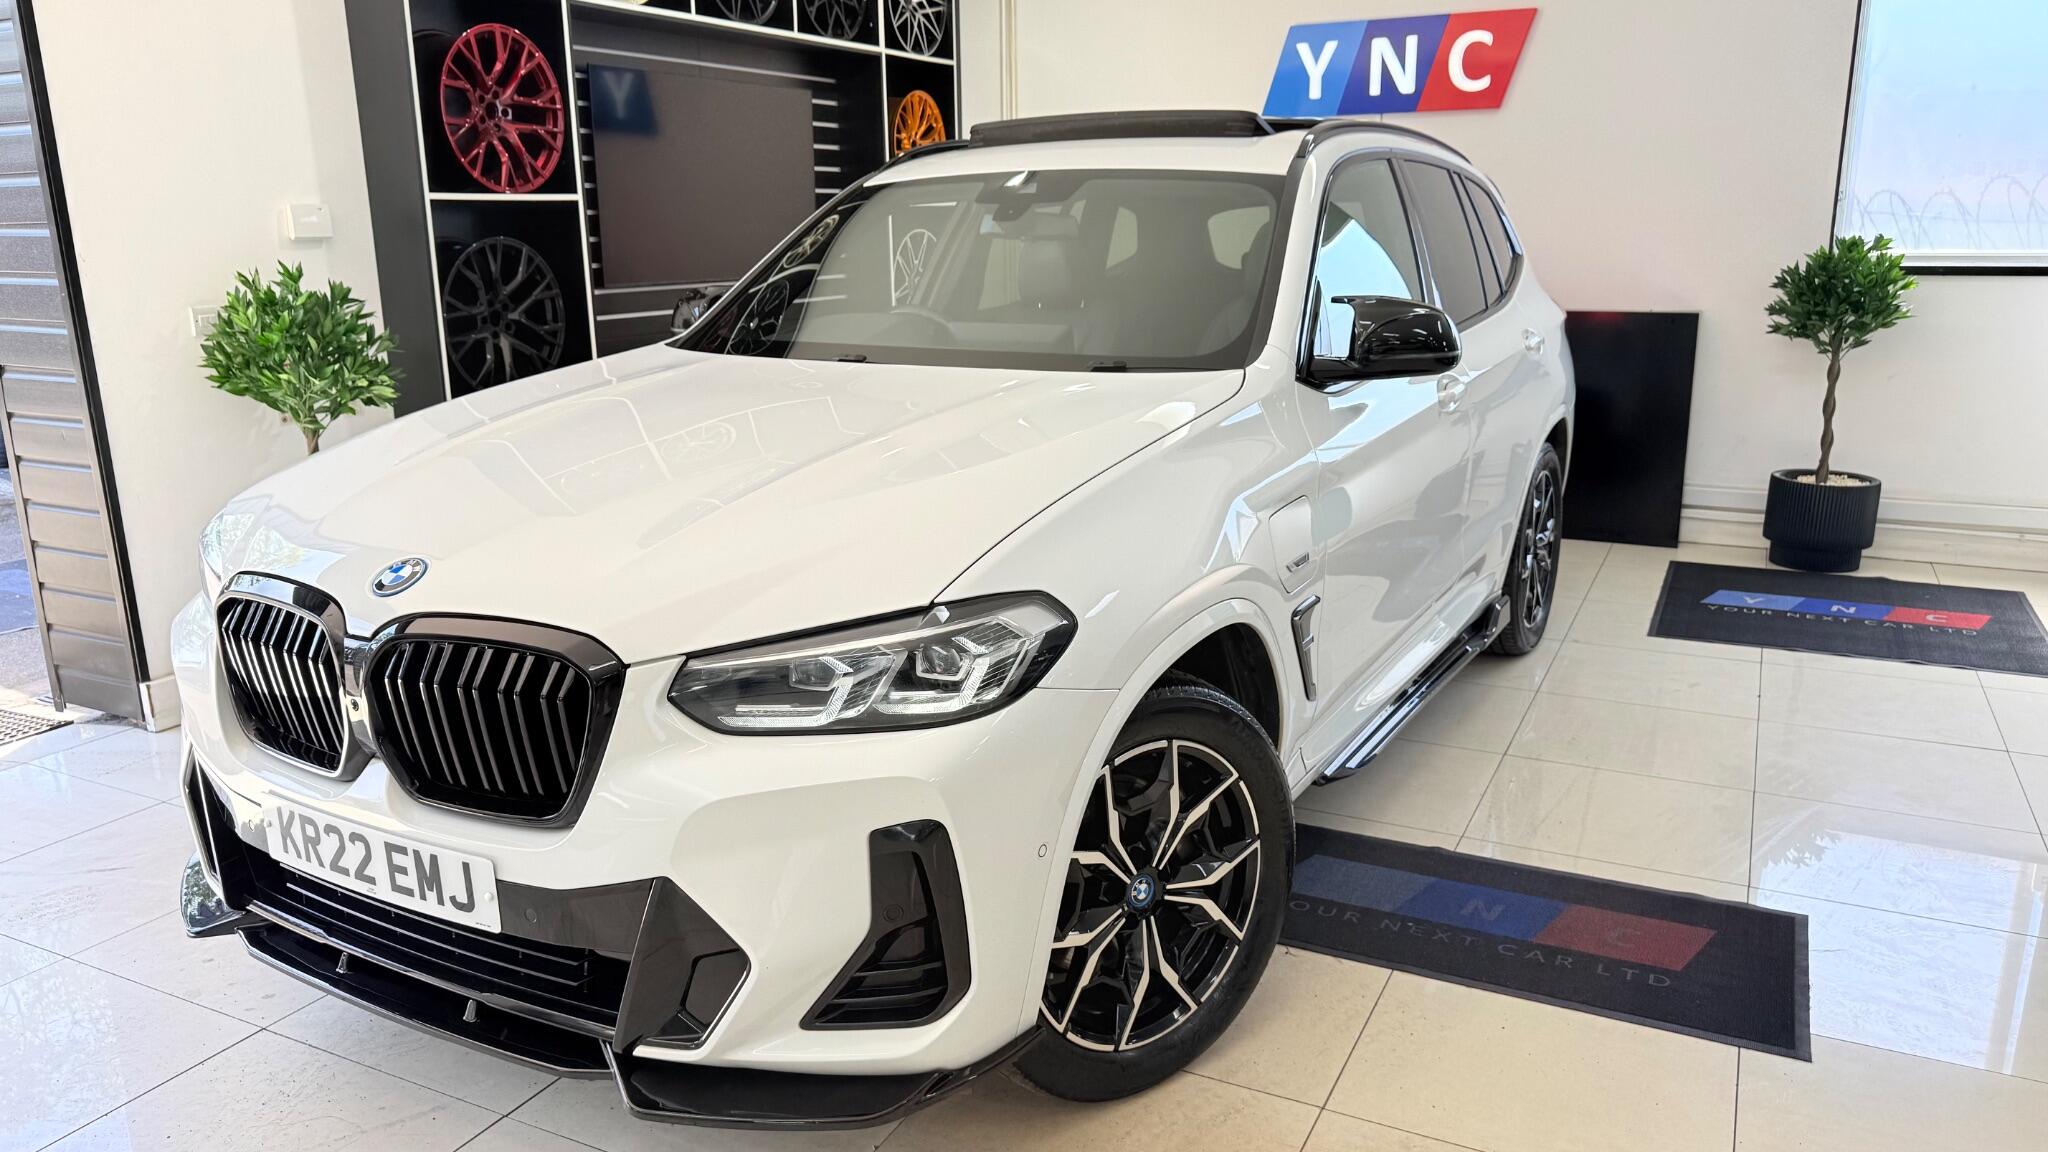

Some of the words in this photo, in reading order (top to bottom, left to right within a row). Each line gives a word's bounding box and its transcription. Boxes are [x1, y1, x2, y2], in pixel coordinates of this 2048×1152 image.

[1706, 604, 1773, 615] YOUR
[1786, 611, 1850, 624] NEXT
[1863, 619, 1914, 630] CAR
[1929, 625, 1977, 637] LTD
[277, 806, 377, 887] KR22
[383, 840, 476, 914] EMJ
[1459, 898, 1508, 921] N
[1289, 900, 1361, 923] OUR
[1379, 918, 1477, 945] NEXT
[1496, 943, 1574, 969] CAR
[1596, 963, 1671, 988] LTD
